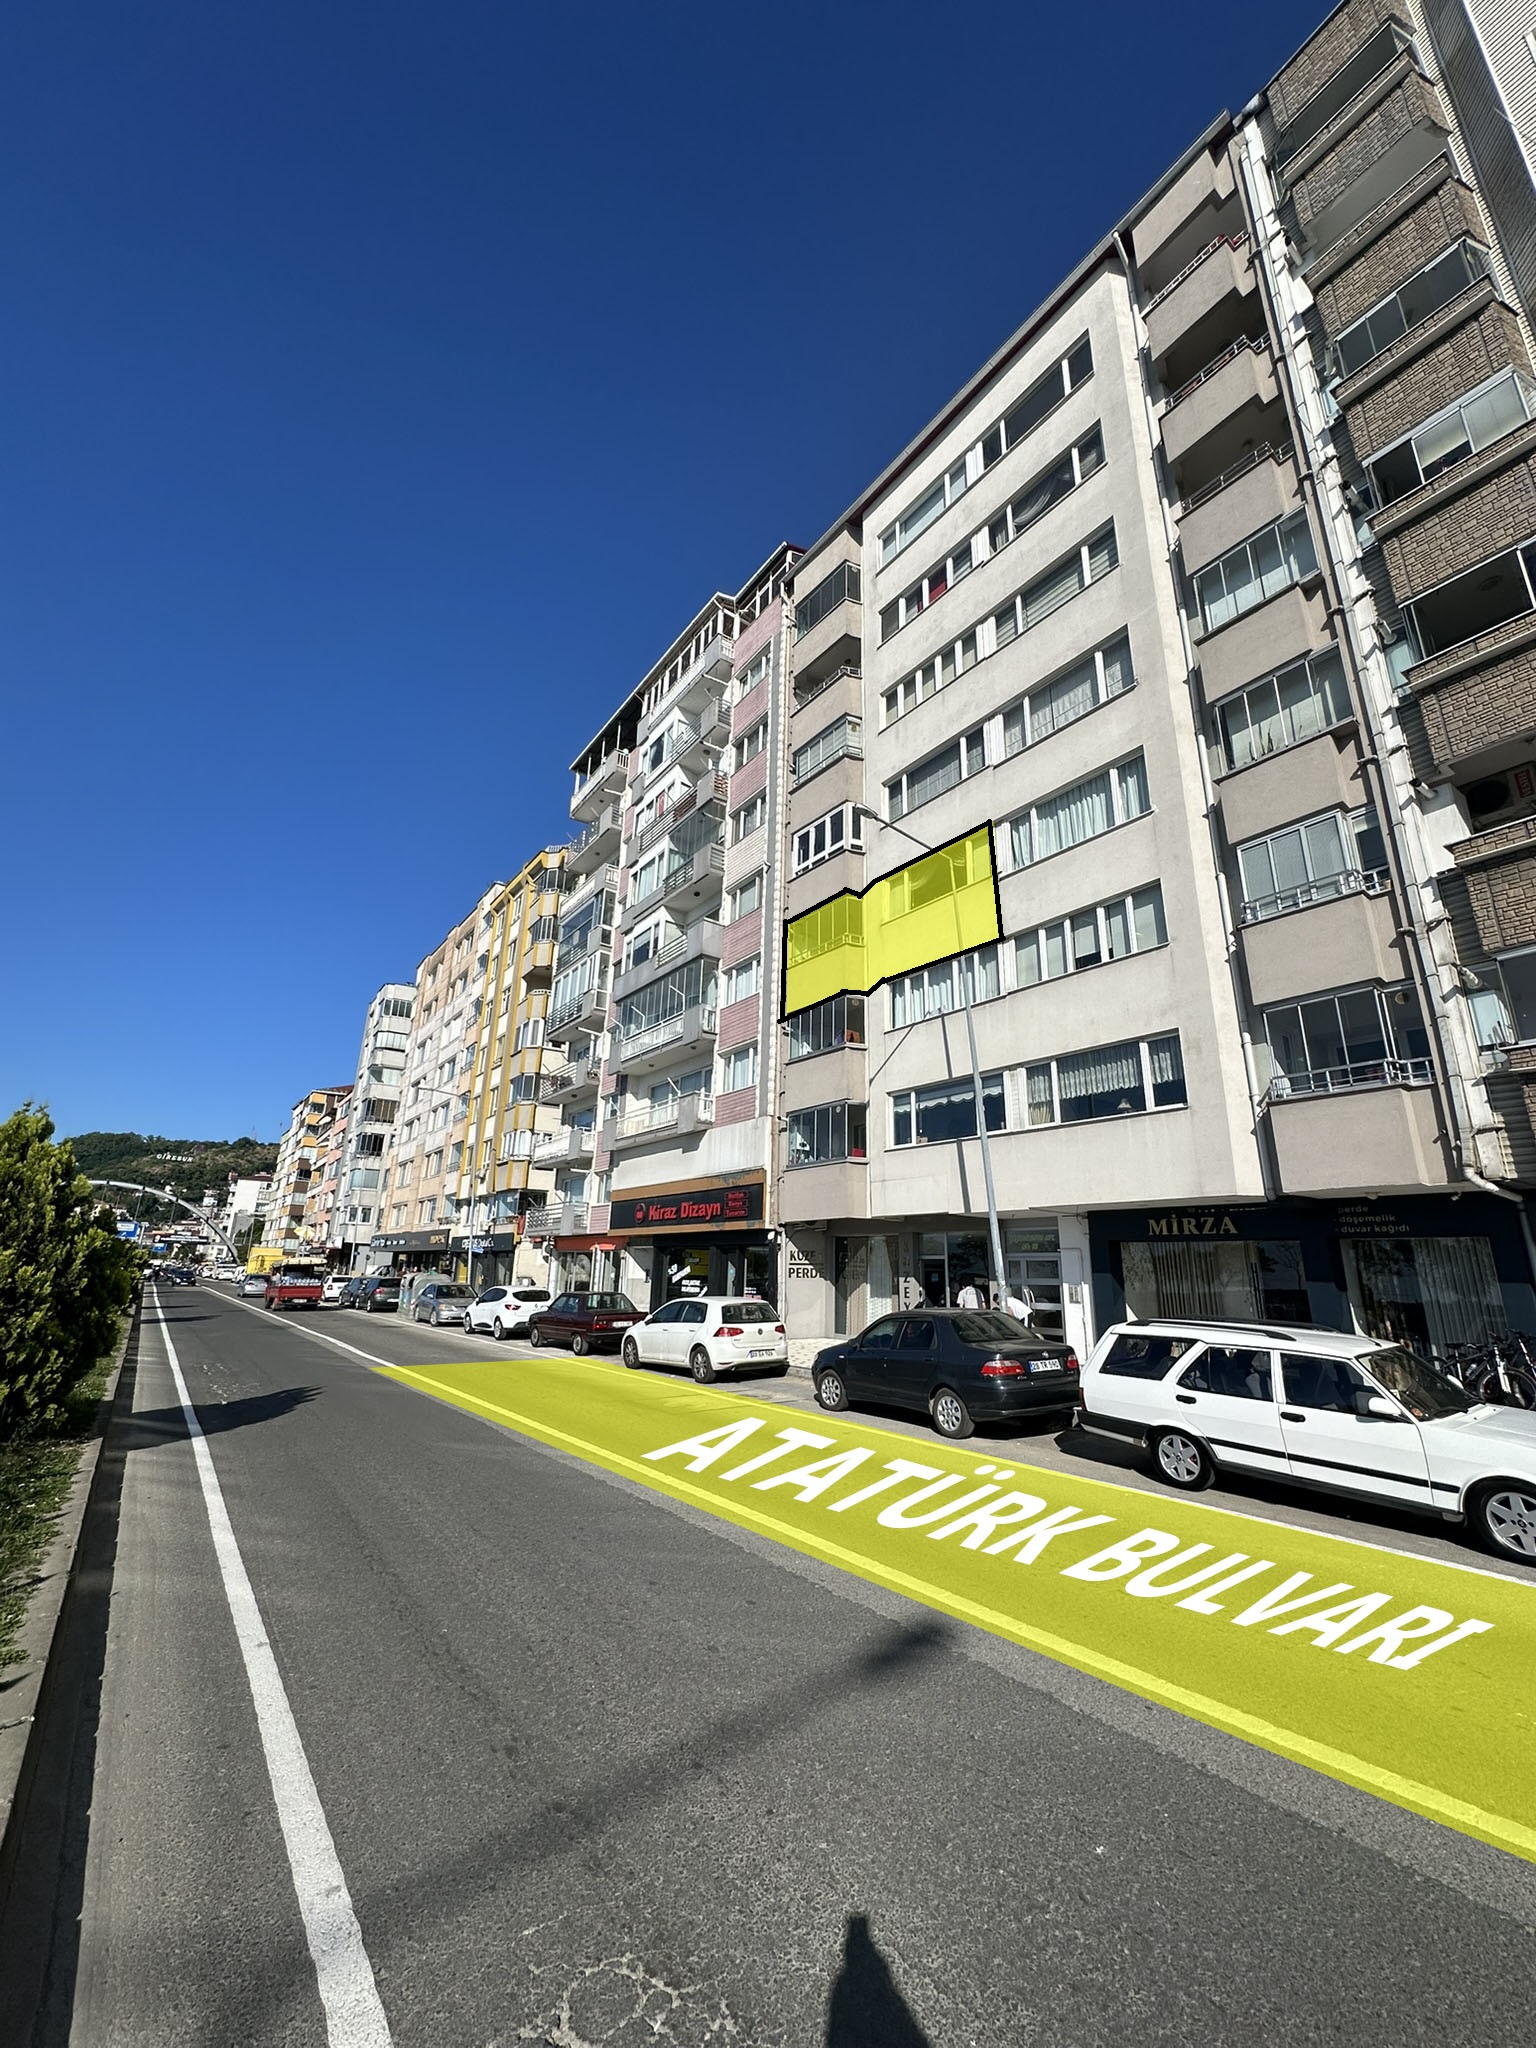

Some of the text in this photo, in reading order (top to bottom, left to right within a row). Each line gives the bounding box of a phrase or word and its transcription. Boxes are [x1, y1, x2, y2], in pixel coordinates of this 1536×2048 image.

[648, 1201, 721, 1221] Kiraz Dizayn
[1147, 1213, 1239, 1236] MİRZA
[1341, 1225, 1371, 1233] duvar
[789, 1267, 825, 1279] PERDE
